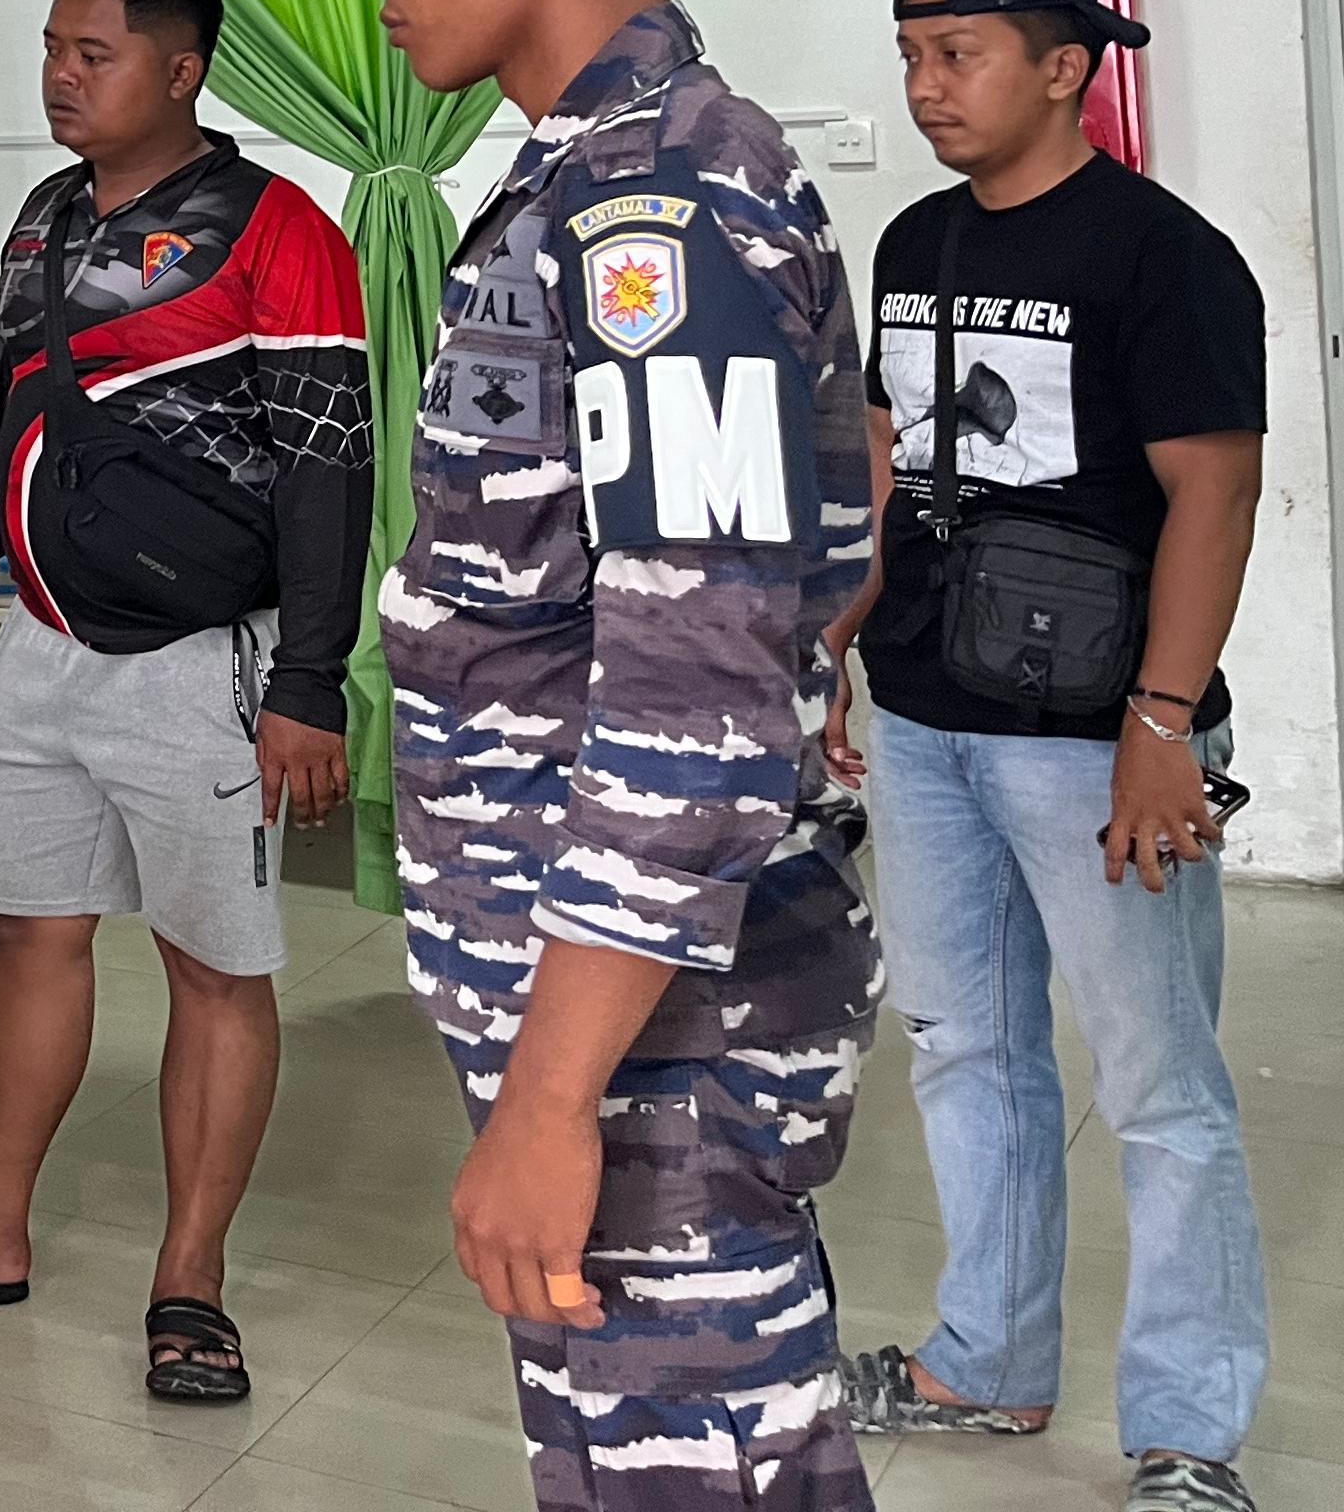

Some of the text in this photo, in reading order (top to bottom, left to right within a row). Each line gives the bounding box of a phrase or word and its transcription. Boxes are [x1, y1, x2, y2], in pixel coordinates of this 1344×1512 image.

[579, 199, 660, 231] LANTAMAL
[880, 292, 937, 325] BROK
[970, 296, 1012, 328] THE
[1010, 299, 1071, 337] NEW
[574, 355, 792, 548] PM
